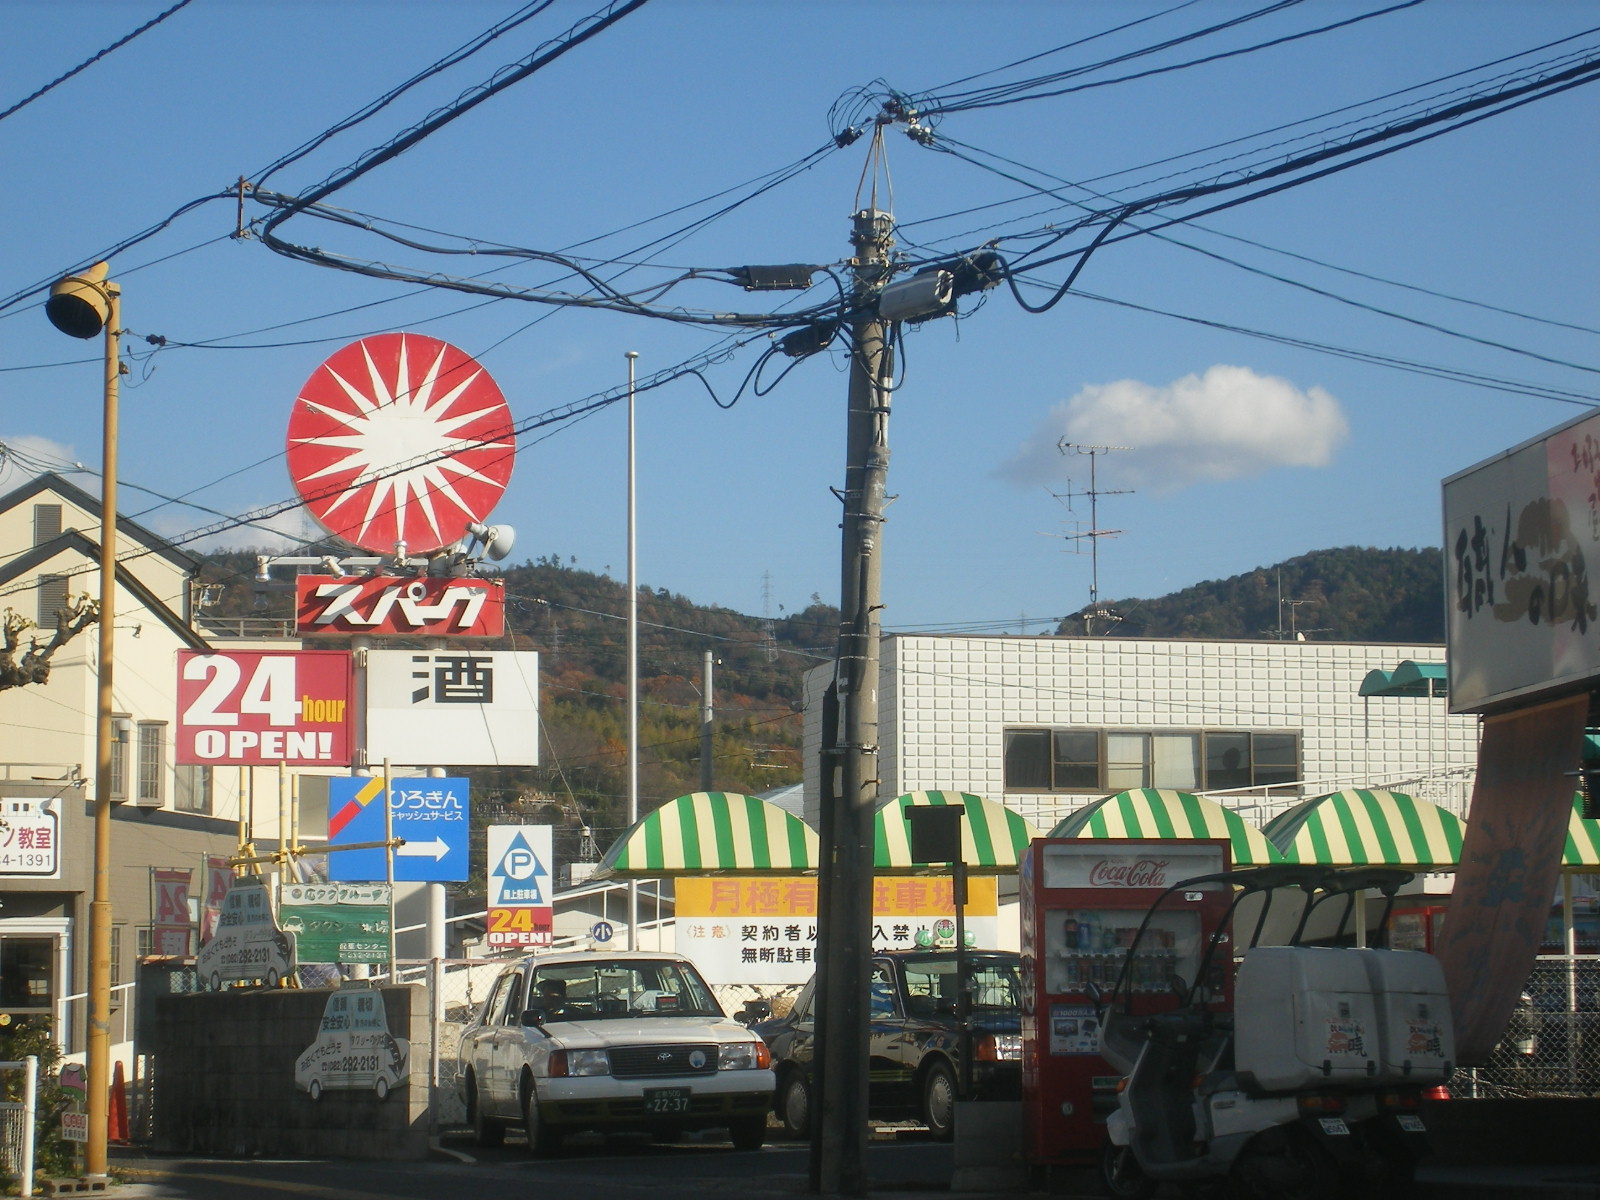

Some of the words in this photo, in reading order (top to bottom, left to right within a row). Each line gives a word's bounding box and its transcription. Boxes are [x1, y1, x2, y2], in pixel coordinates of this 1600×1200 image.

[314, 581, 489, 628] スパーク
[182, 654, 303, 726] 24
[302, 694, 346, 723] hour
[412, 655, 493, 704] 酒
[194, 730, 332, 760] OPEN!
[390, 790, 463, 809] ひろぎん
[511, 852, 531, 875] P
[1088, 859, 1170, 887] Coca-Cola
[490, 909, 534, 932] 24
[489, 932, 552, 944] OPEN!
[654, 1097, 689, 1112] 22-37
